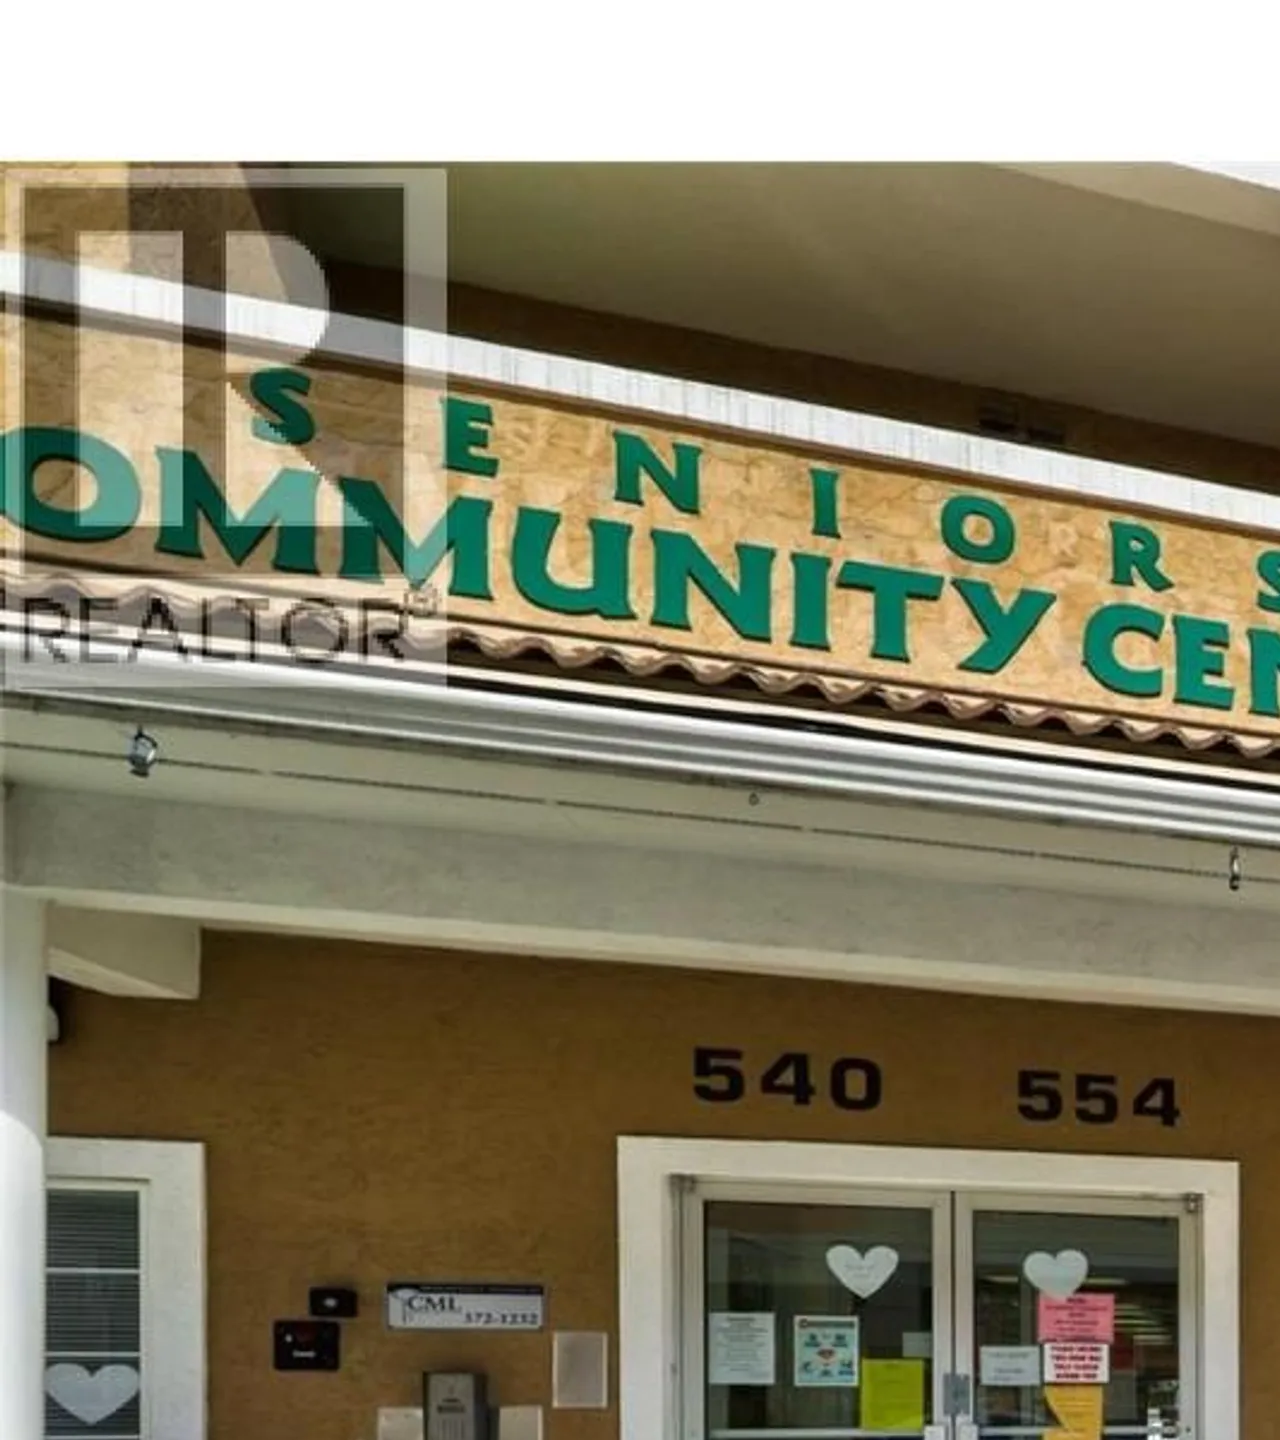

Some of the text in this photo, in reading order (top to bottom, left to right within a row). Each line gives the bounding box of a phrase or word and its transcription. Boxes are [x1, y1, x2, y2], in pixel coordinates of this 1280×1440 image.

[0, 425, 1057, 674] OMMUNITY
[692, 1047, 1181, 1128] 540 554
[408, 1294, 461, 1313] CML
